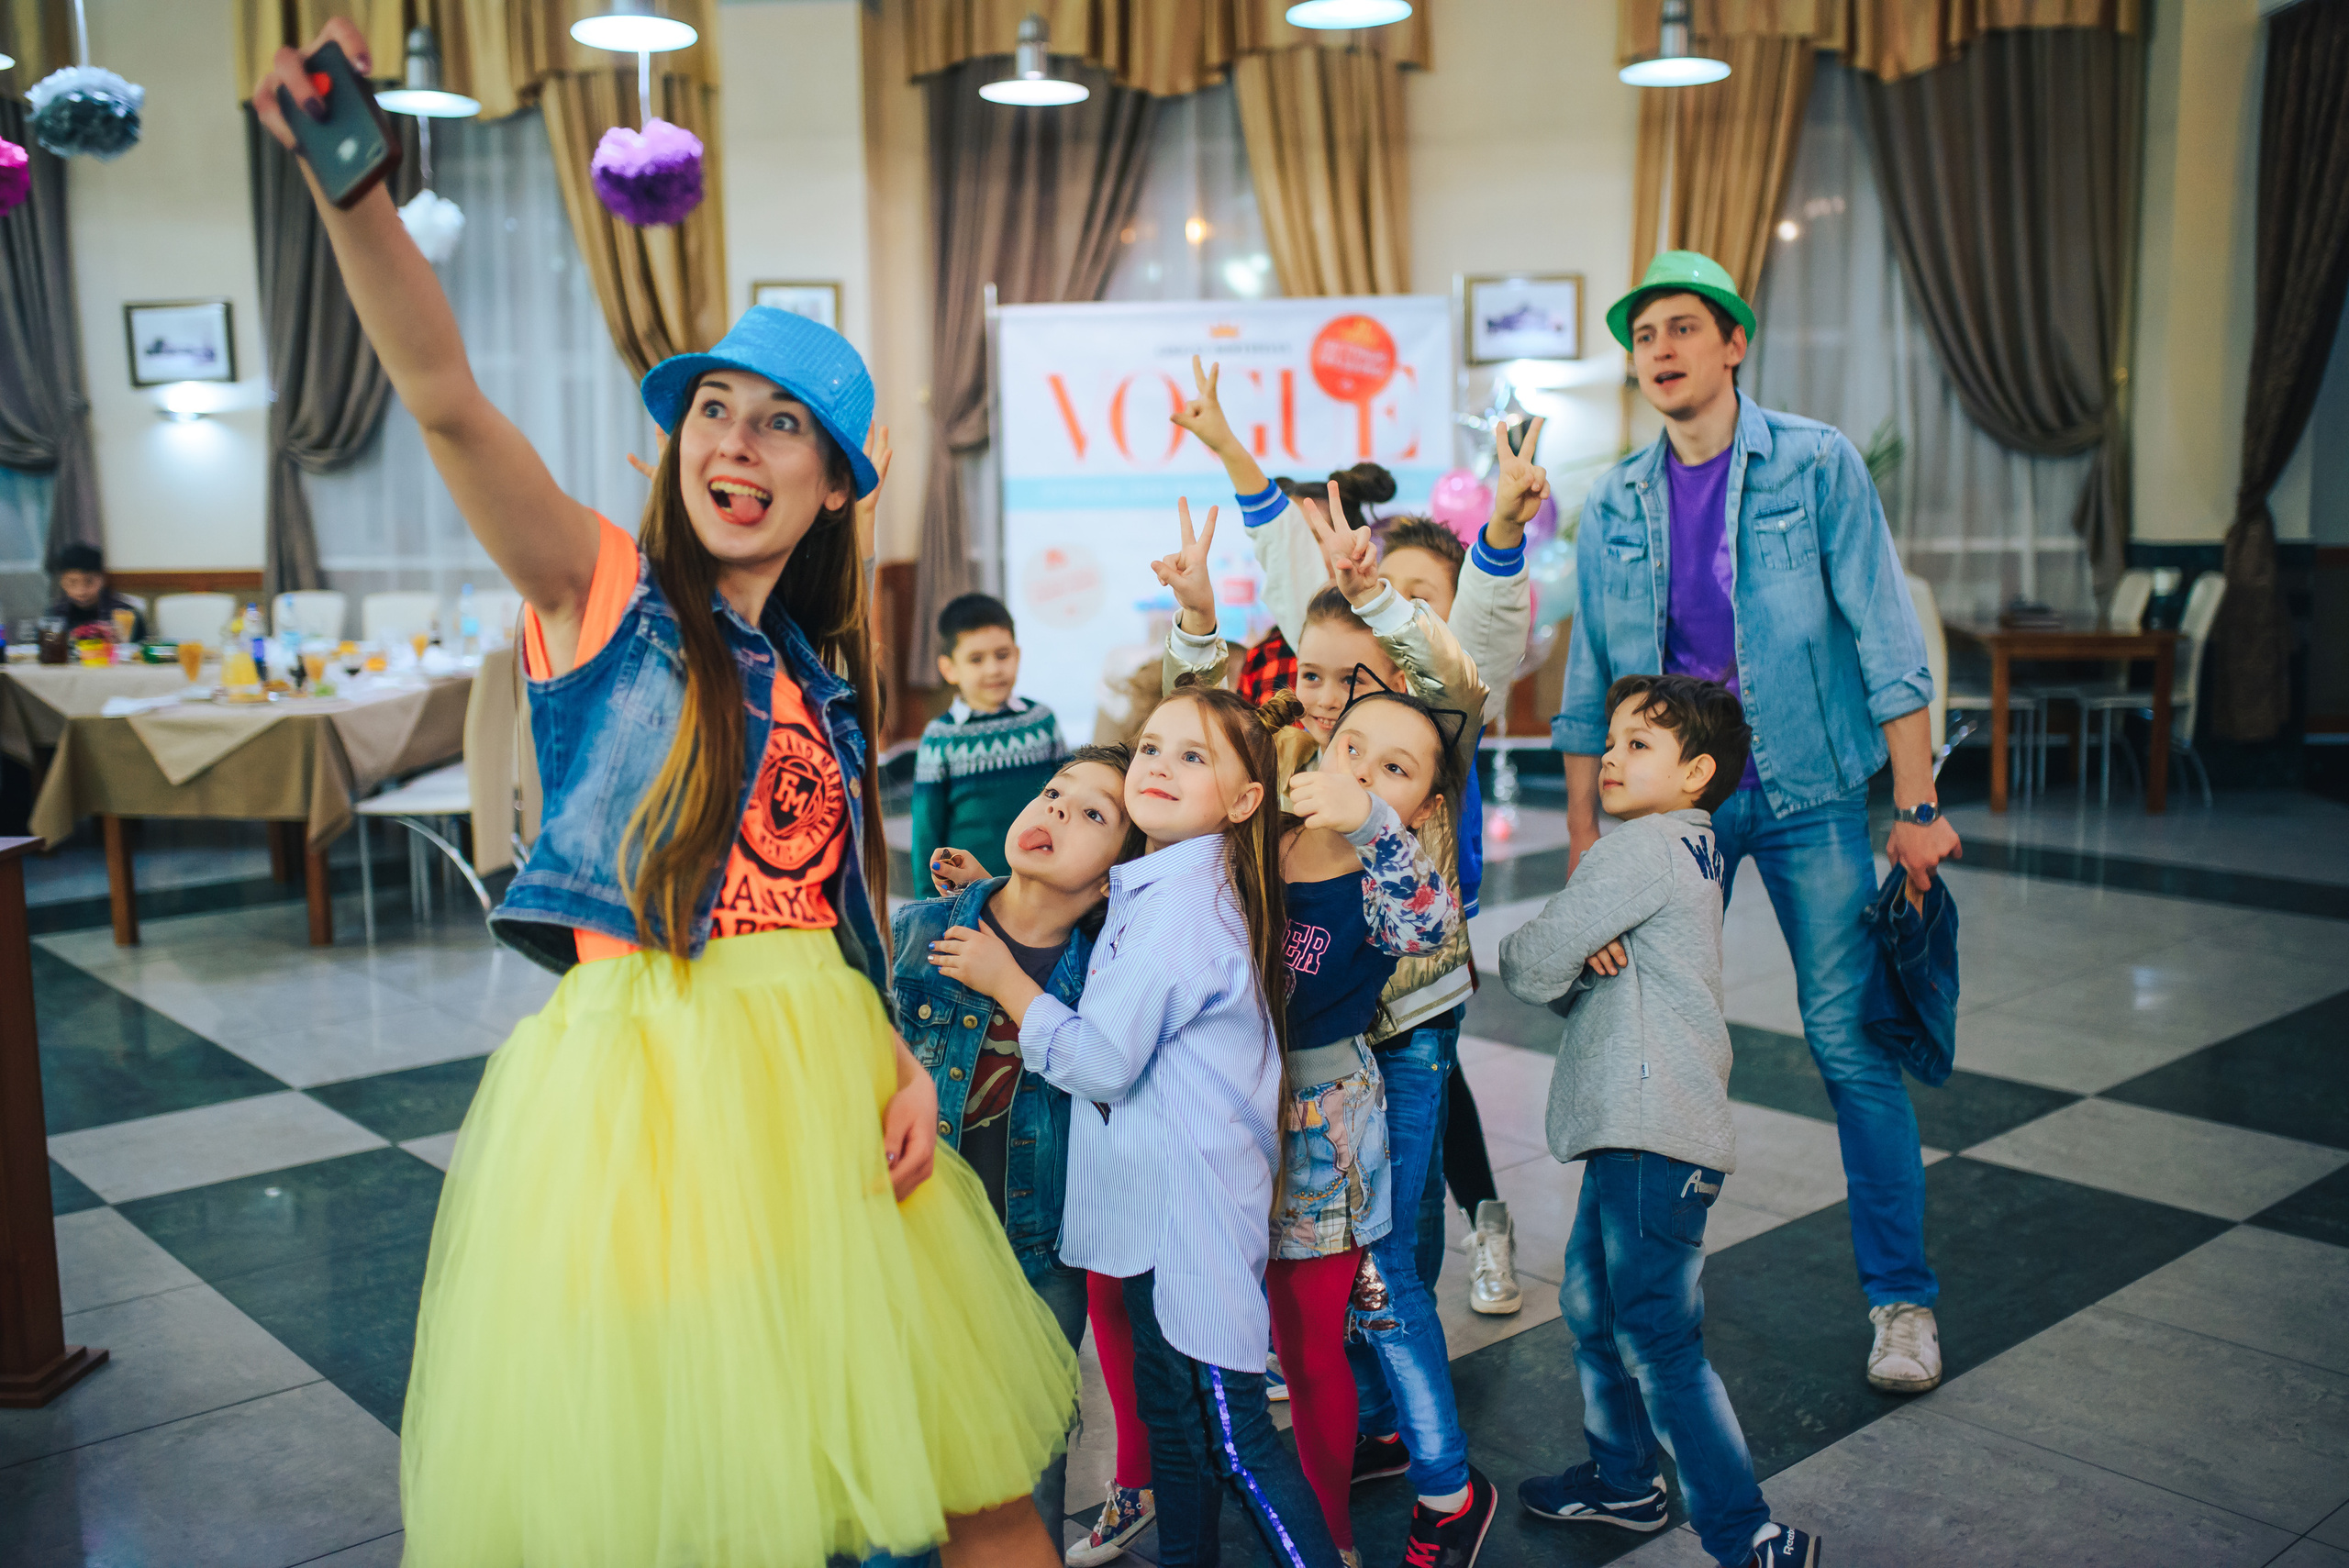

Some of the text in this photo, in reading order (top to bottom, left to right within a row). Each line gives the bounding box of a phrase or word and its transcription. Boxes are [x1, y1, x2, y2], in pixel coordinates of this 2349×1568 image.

[774, 771, 809, 817] FM
[1282, 918, 1331, 975] ER
[1782, 1528, 1796, 1556] Reeb
